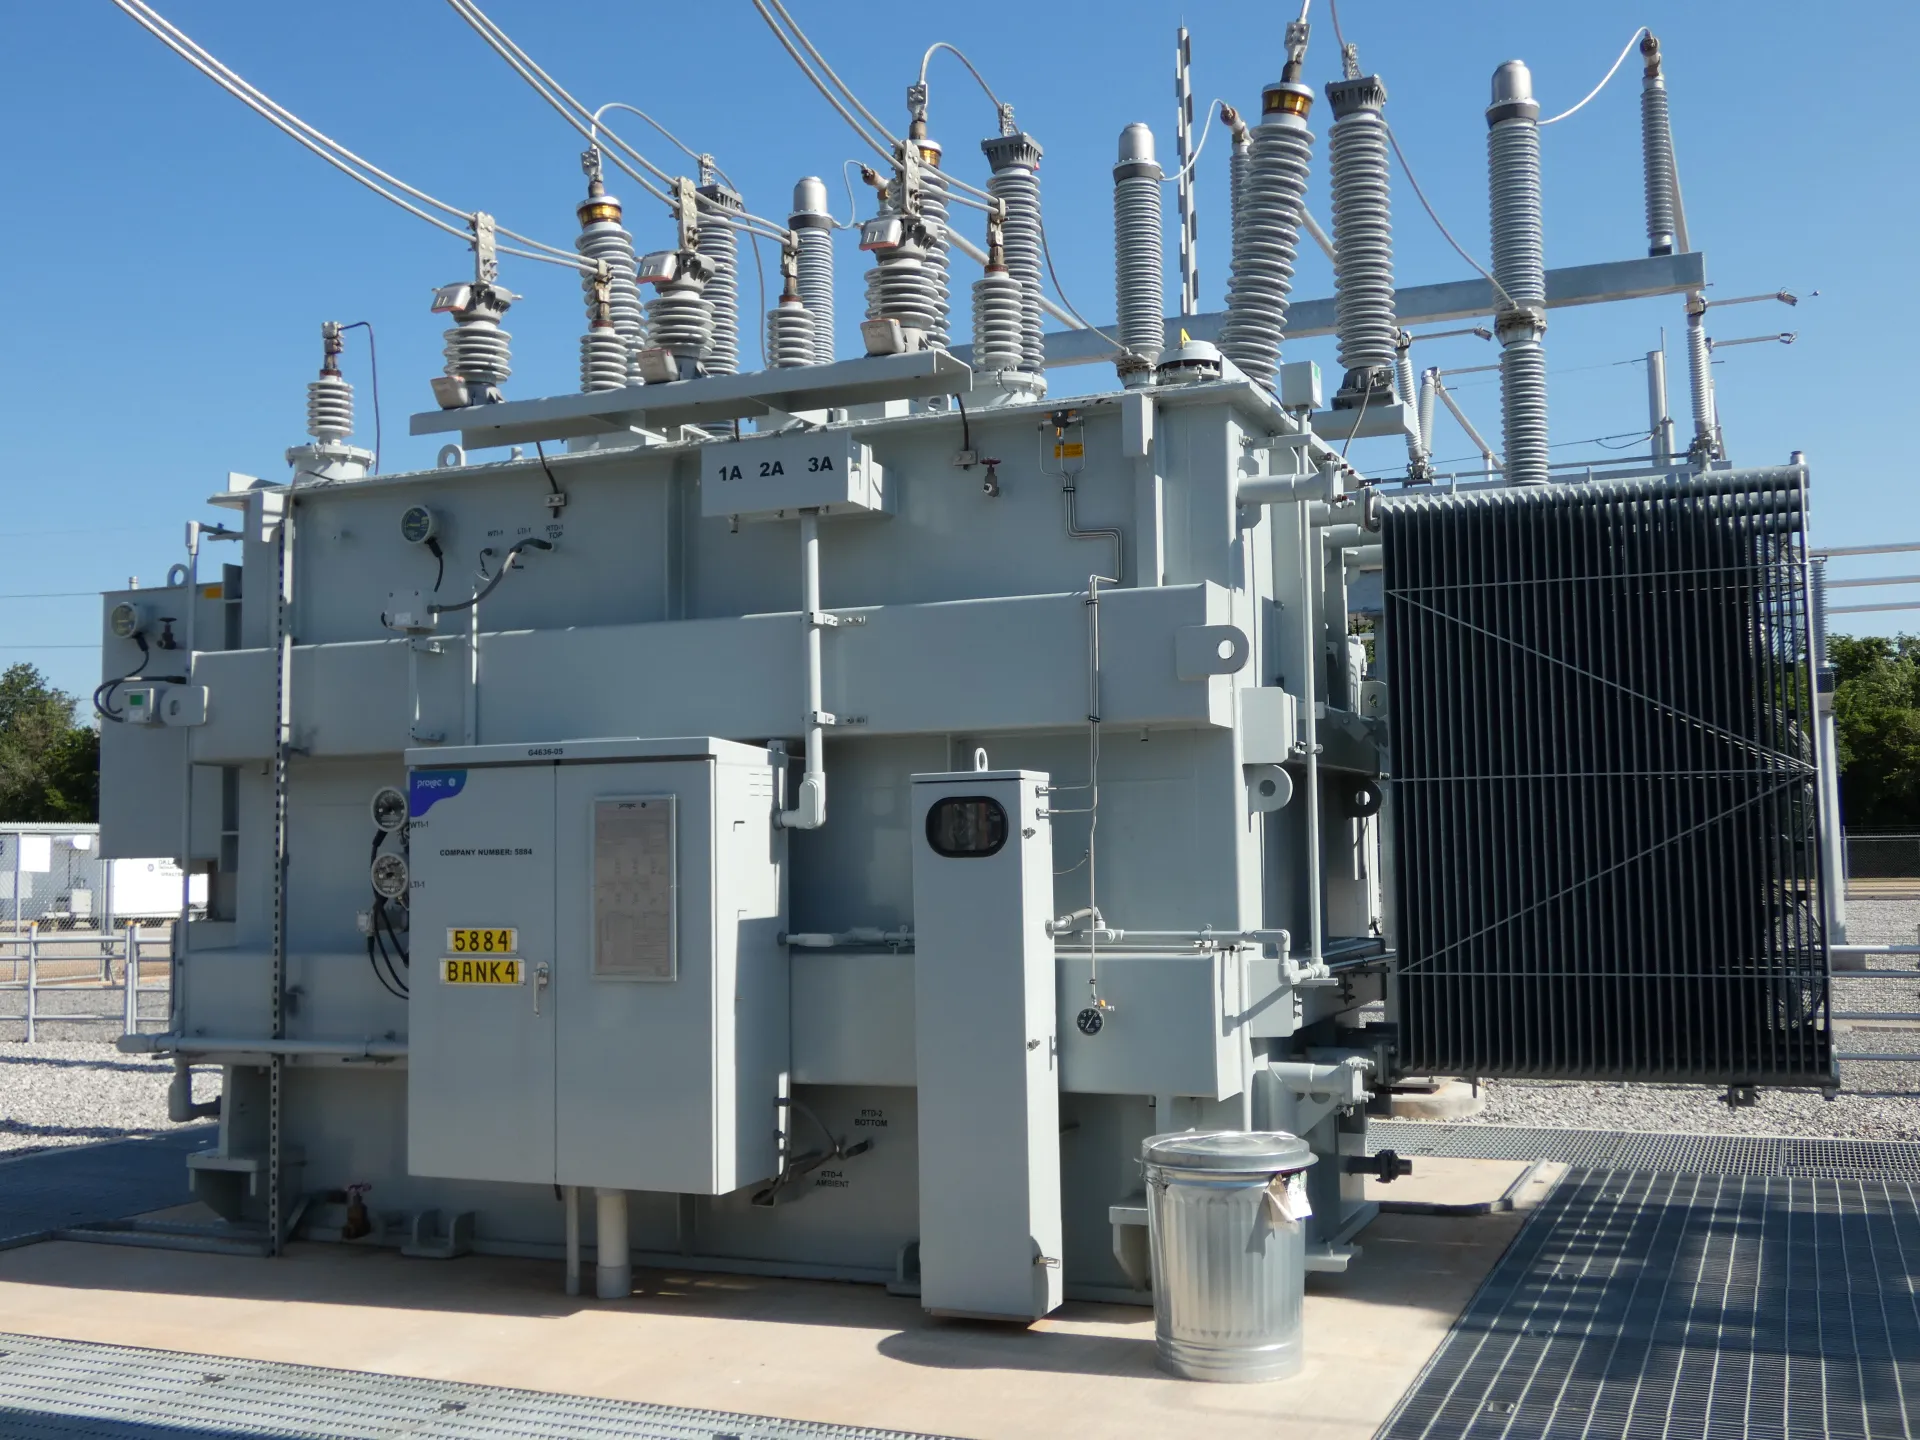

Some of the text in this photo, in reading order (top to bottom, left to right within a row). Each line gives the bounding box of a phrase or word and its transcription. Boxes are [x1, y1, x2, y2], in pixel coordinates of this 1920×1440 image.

[718, 455, 834, 481] 1A 2A 3A
[545, 524, 564, 532] RTD-1
[548, 531, 563, 539] TOP
[439, 847, 533, 857] COMPANY NUMBER: 5884
[409, 880, 426, 889] LTI-1
[454, 930, 508, 952] 5884
[861, 1109, 883, 1118] RTD-2
[854, 1118, 888, 1127] BOTTOM
[821, 1170, 843, 1179] RTD-4
[815, 1179, 850, 1188] AMBIENT
